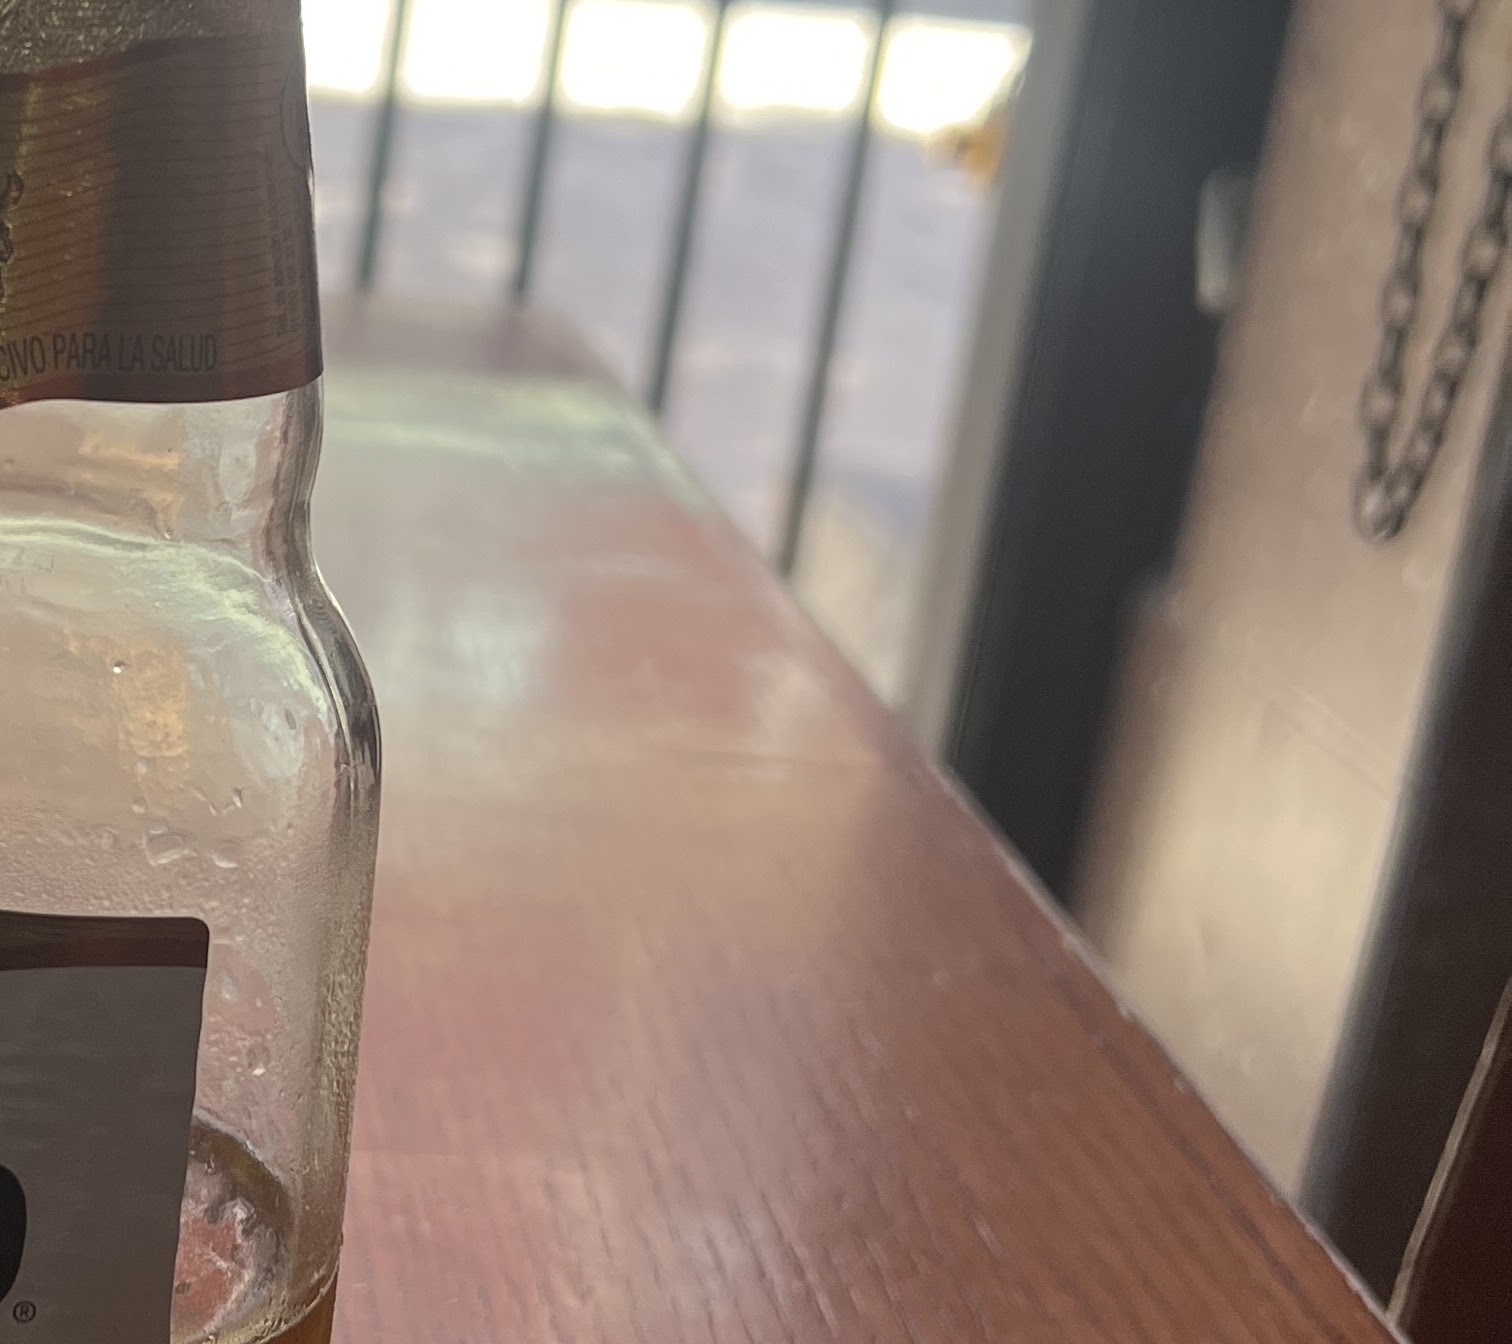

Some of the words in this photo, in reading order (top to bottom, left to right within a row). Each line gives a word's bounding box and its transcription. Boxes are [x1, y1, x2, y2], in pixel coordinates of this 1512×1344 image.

[52, 332, 110, 371] PARA
[118, 334, 144, 372] LA
[151, 332, 218, 373] SALUD
